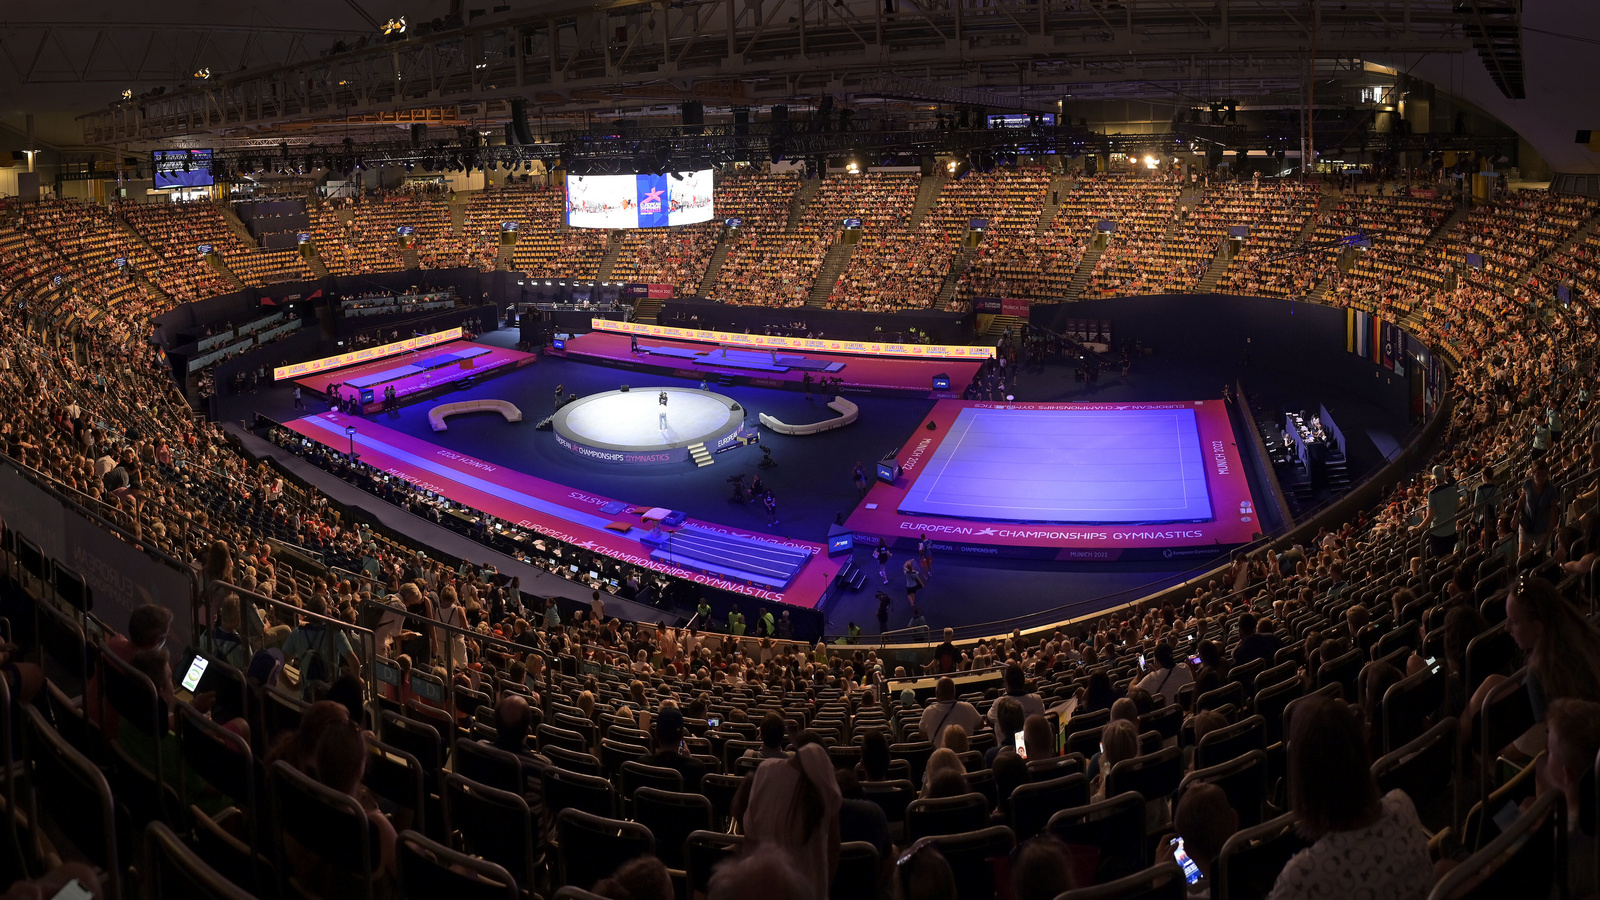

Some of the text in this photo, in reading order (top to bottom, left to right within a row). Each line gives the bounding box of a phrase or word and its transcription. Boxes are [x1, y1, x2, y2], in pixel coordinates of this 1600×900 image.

[437, 450, 496, 472] MUNICH 2022
[555, 434, 669, 462] EUROPEAN CHAMPIONSHIPS GYMNASTICS
[902, 438, 932, 470] MUNICH 2022
[1212, 440, 1229, 474] MUNICH 2022
[385, 468, 444, 493] MUNICH 2022
[900, 522, 1202, 540] EUROPEAN CHAMPIONSHIPS GYMNASTICS
[518, 520, 784, 602] EUROPEAN CHAMPIONSHIPS GYMNASTICS
